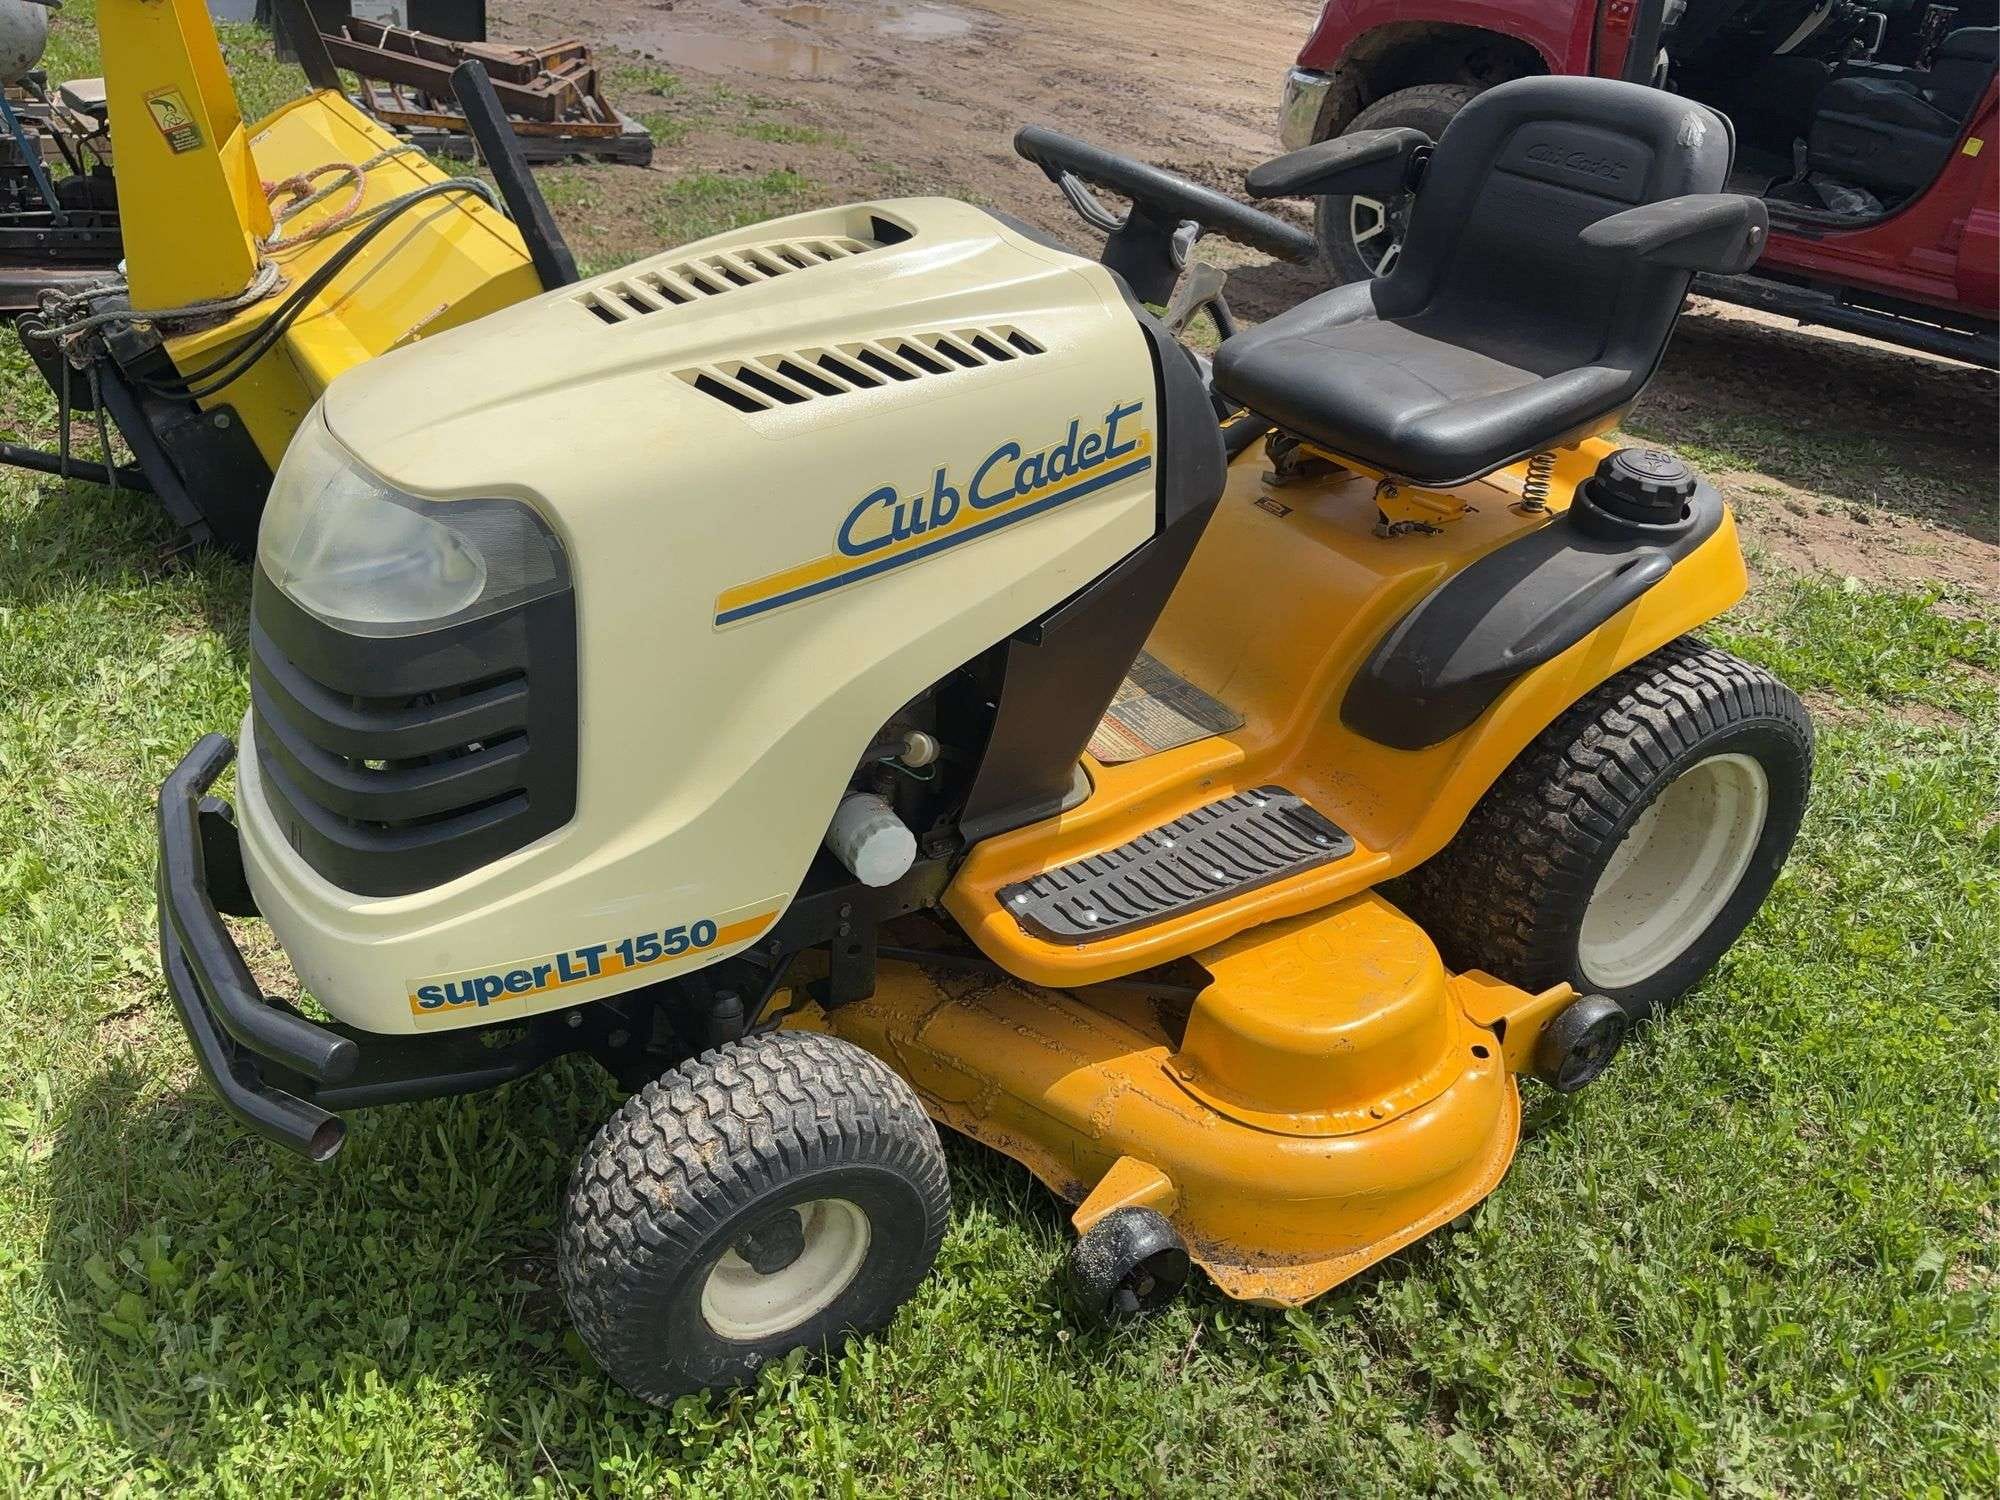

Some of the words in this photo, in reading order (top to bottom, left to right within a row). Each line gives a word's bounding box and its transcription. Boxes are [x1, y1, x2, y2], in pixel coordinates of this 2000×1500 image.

[837, 468, 961, 556] Cub
[968, 401, 1143, 510] Cadet
[614, 919, 718, 967] 1550
